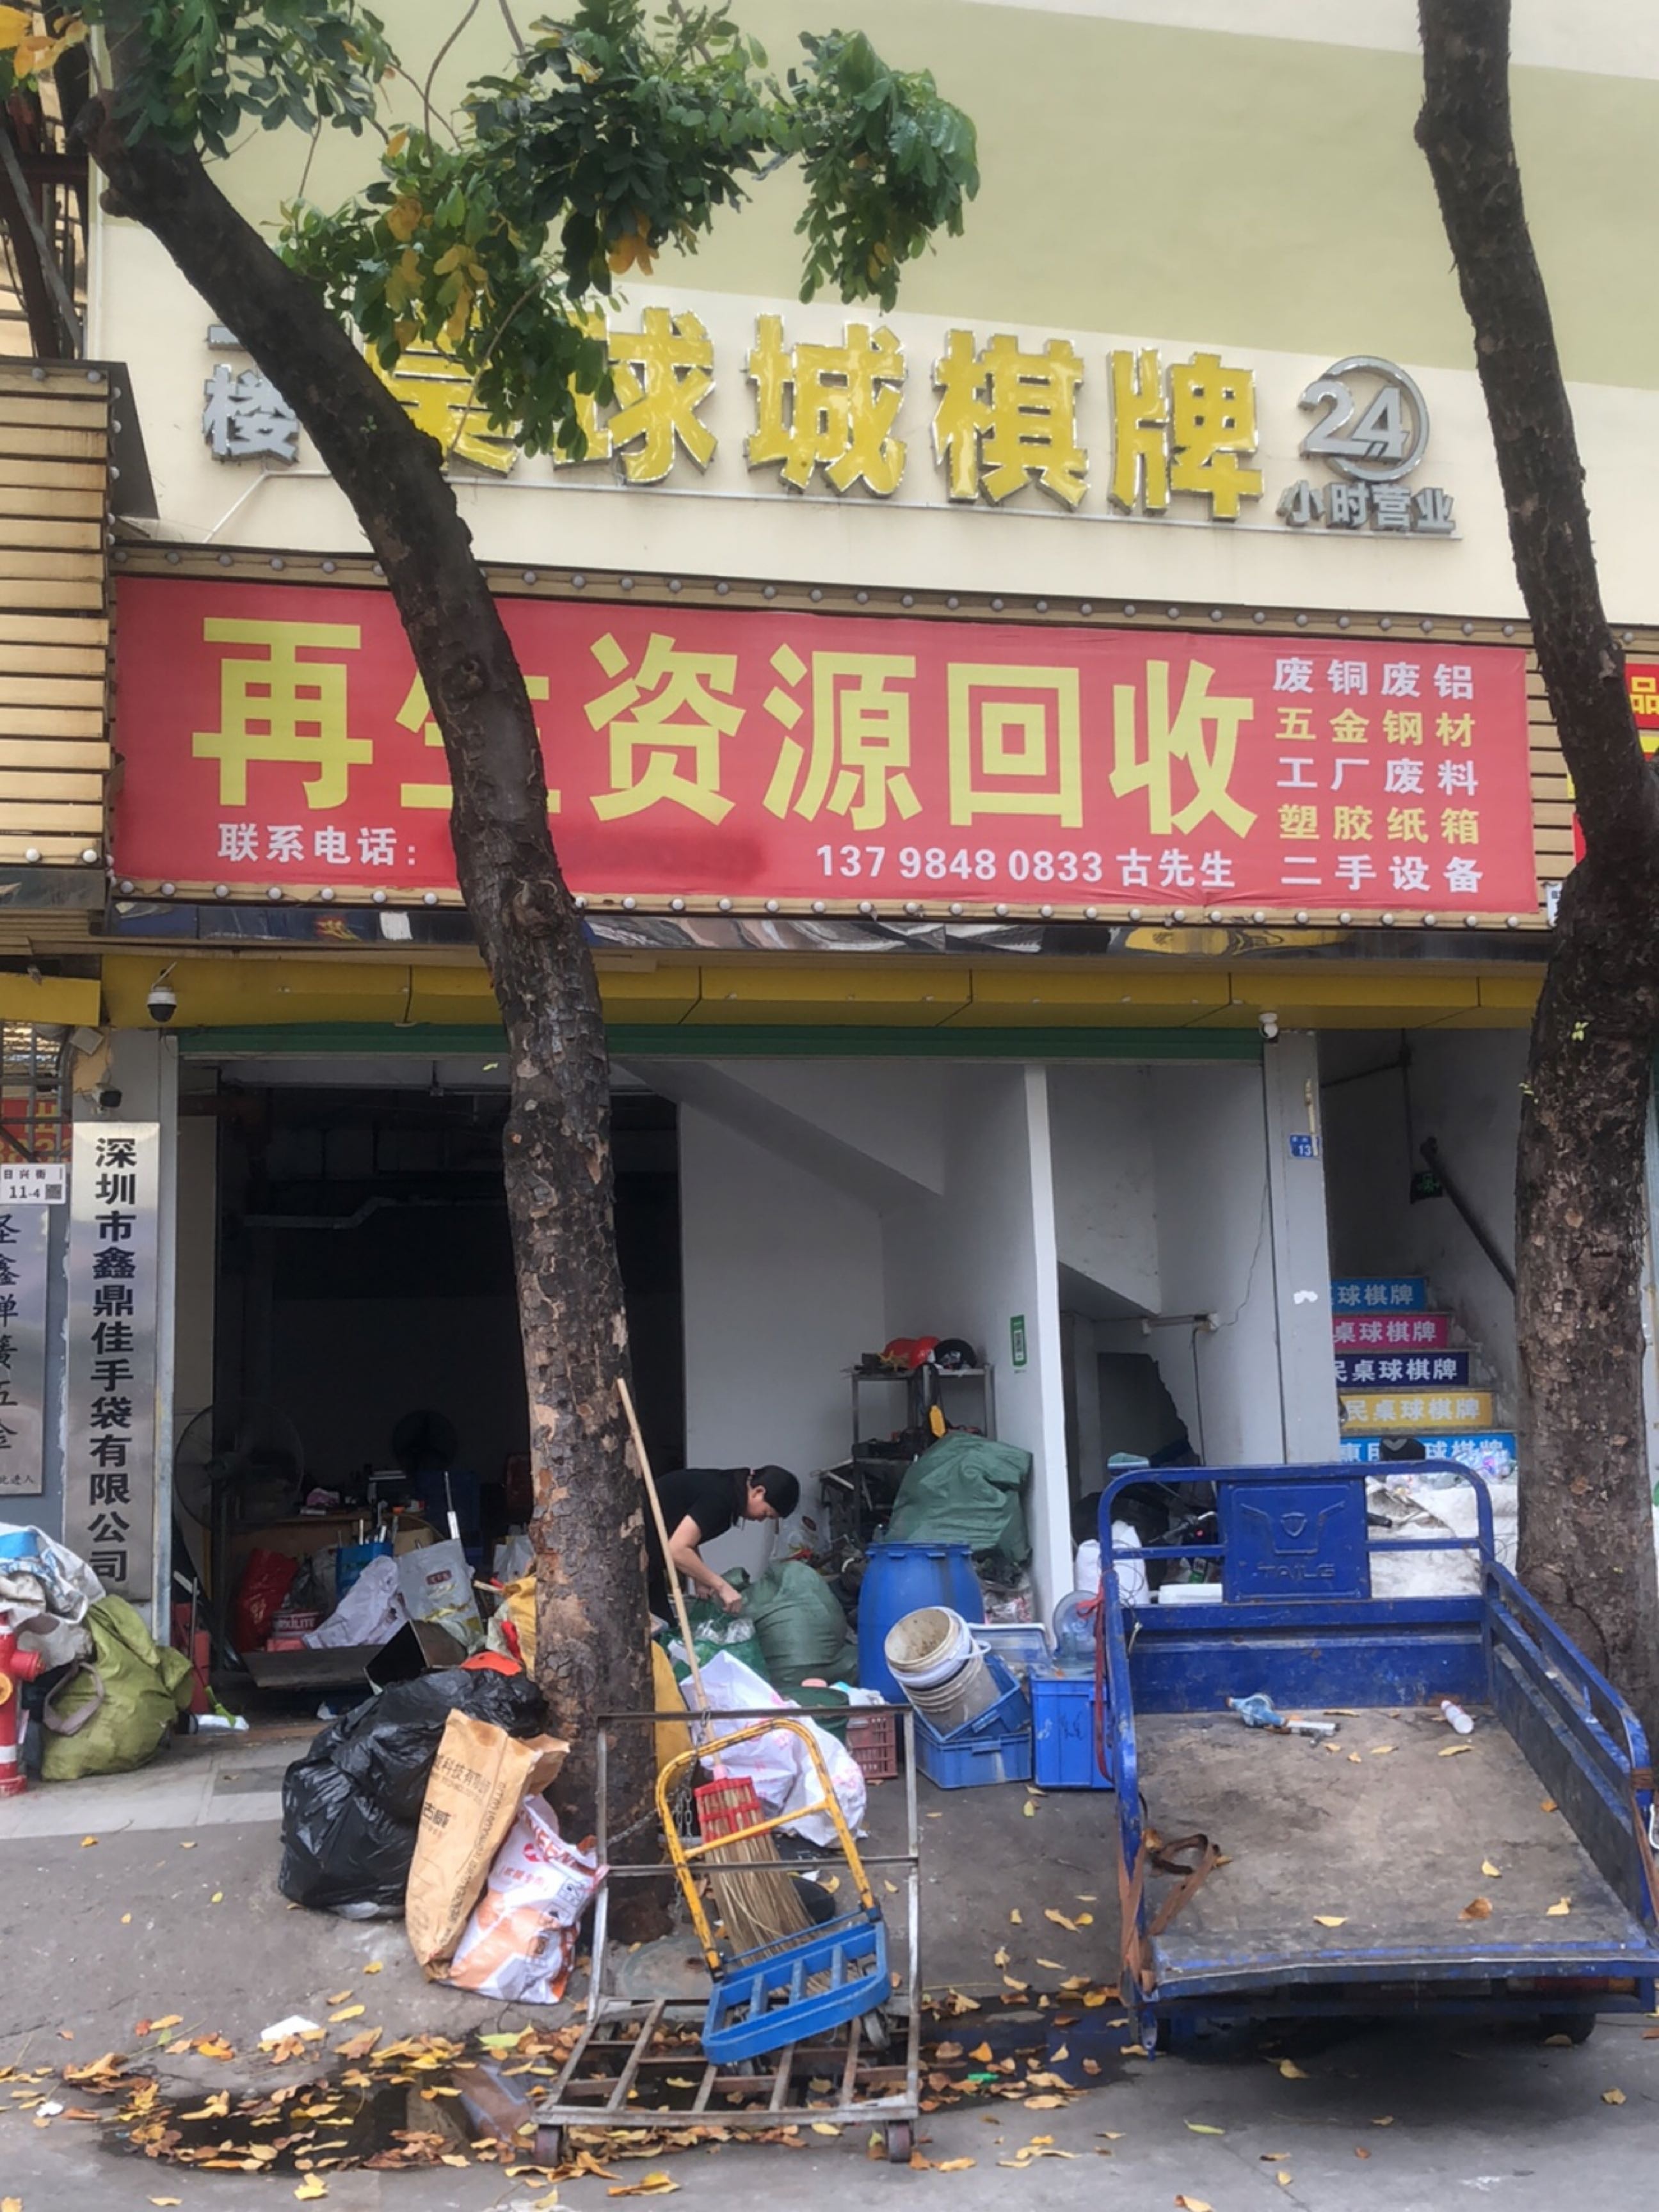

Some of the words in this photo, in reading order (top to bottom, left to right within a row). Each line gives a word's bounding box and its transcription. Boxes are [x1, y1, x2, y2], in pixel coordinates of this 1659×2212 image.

[1298, 374, 1411, 461] 24
[1278, 481, 1455, 533] 小时营业
[1272, 657, 1474, 700] 废铜废铝
[1275, 707, 1475, 748] 五金钢材
[1277, 758, 1478, 796] 工厂废料
[1278, 805, 1480, 844] 塑胶纸箱
[1116, 847, 1235, 888] 古先生
[1281, 854, 1483, 894] 二手设备
[9, 1185, 40, 1199] 11-4
[1331, 1283, 1413, 1306] 球棋牌
[1333, 1320, 1436, 1343] 桌球棋牌
[87, 1137, 138, 1583] 深圳市鑫鼎佳手袋有限公司
[1345, 1398, 1480, 1422] 民桌球棋牌
